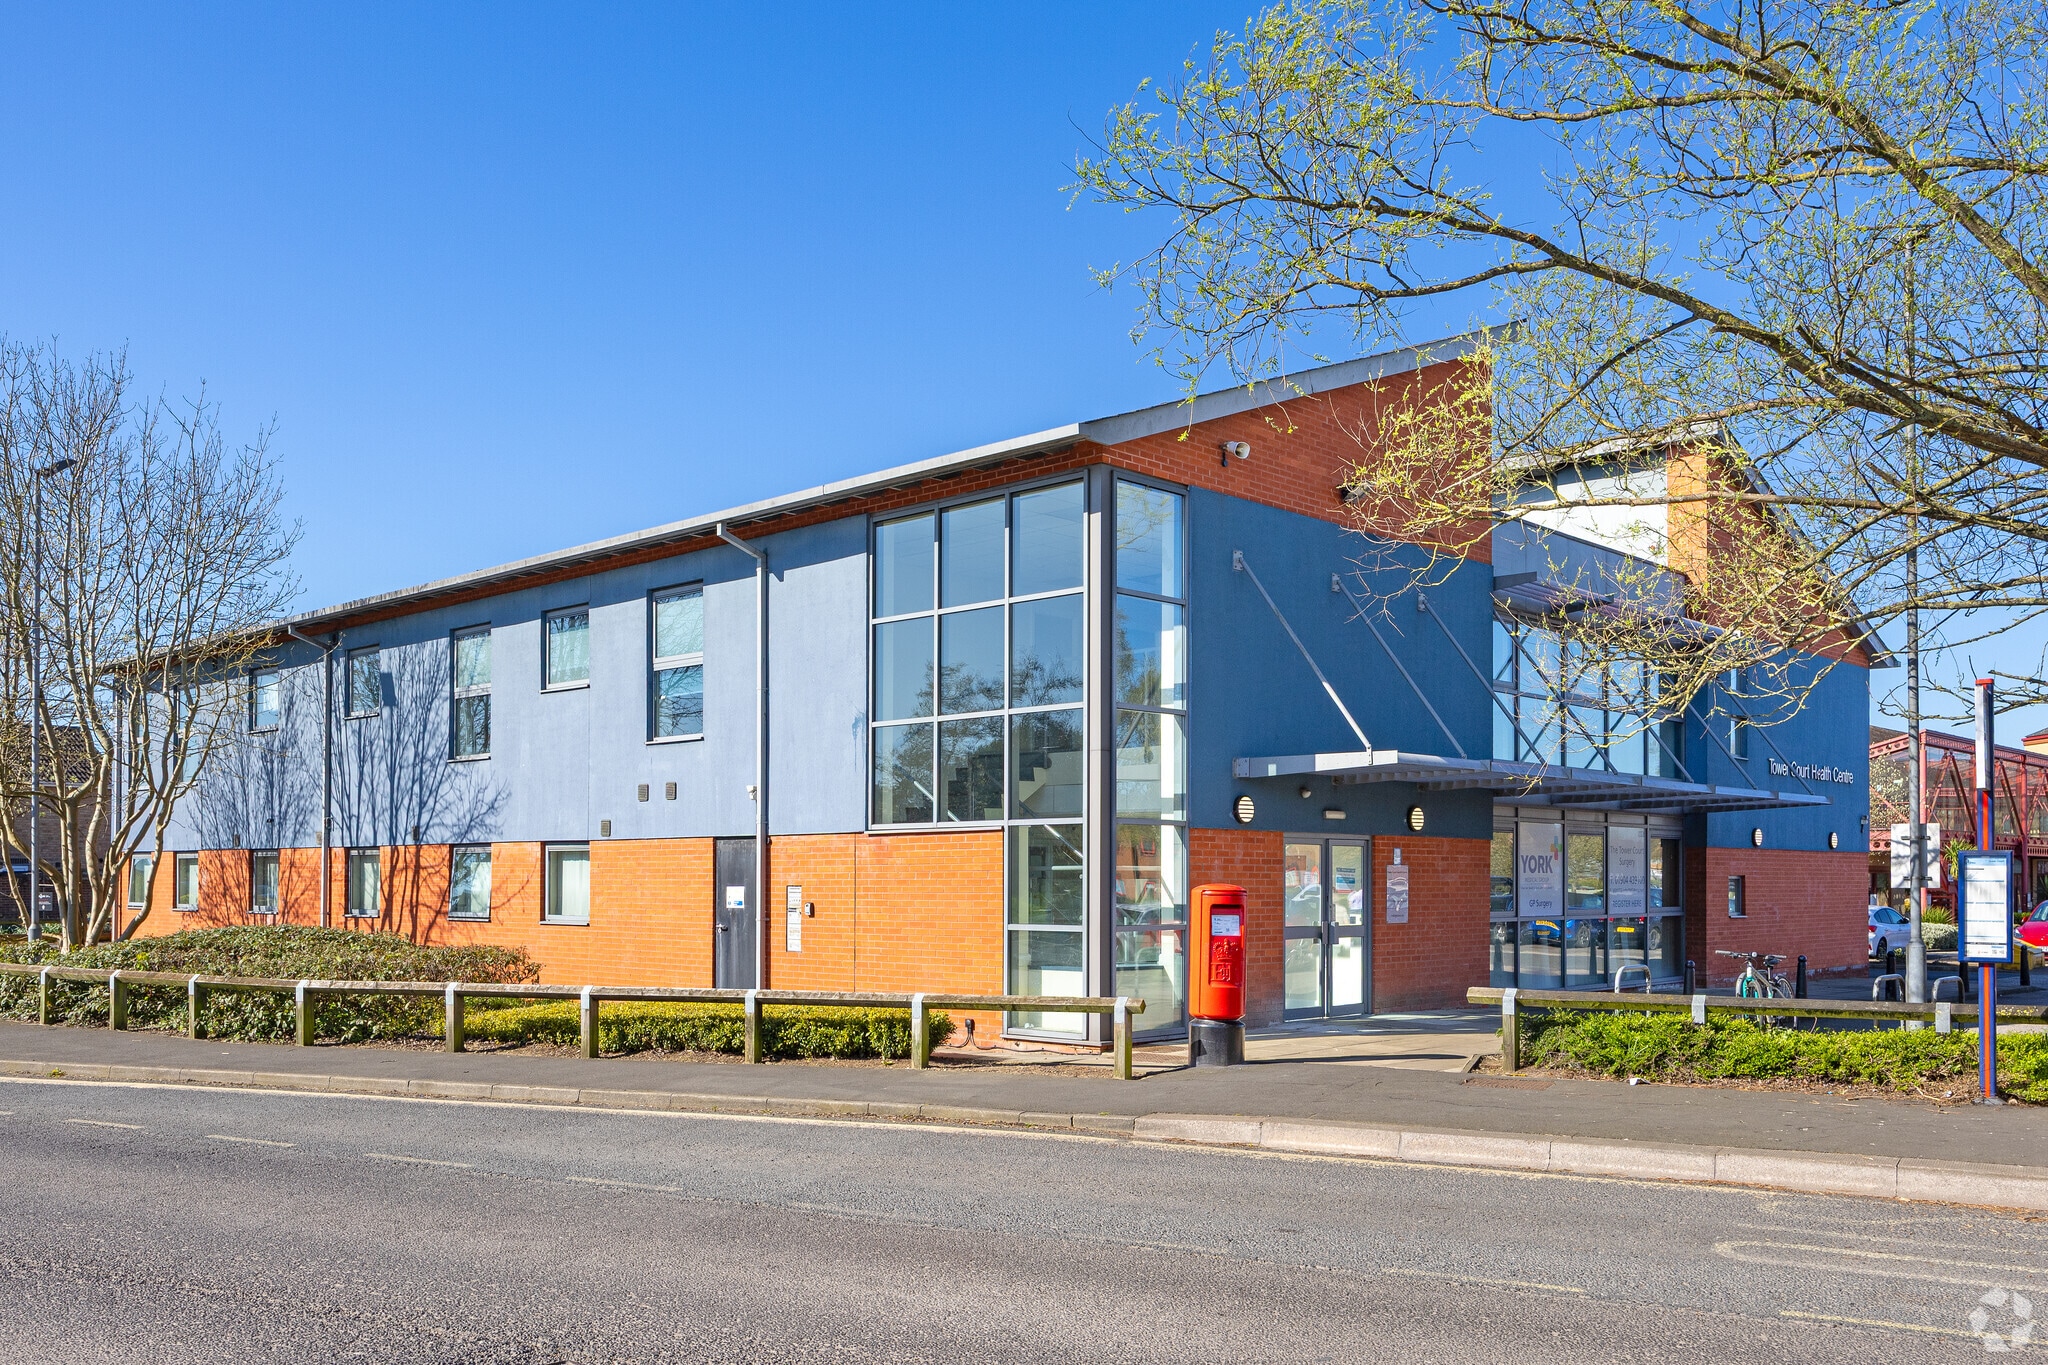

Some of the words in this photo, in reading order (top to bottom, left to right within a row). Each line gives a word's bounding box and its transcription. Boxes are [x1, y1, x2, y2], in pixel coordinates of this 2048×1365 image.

[1768, 758, 1789, 776] Tower
[1790, 761, 1810, 779] Court
[1811, 764, 1832, 781] Health
[1833, 767, 1854, 784] Centre
[1610, 845, 1618, 854] The
[1619, 845, 1632, 854] Tower
[1520, 854, 1553, 874] YORK
[1619, 857, 1635, 868] Surgery
[1529, 899, 1536, 908] GP
[1536, 899, 1553, 909] Surgery
